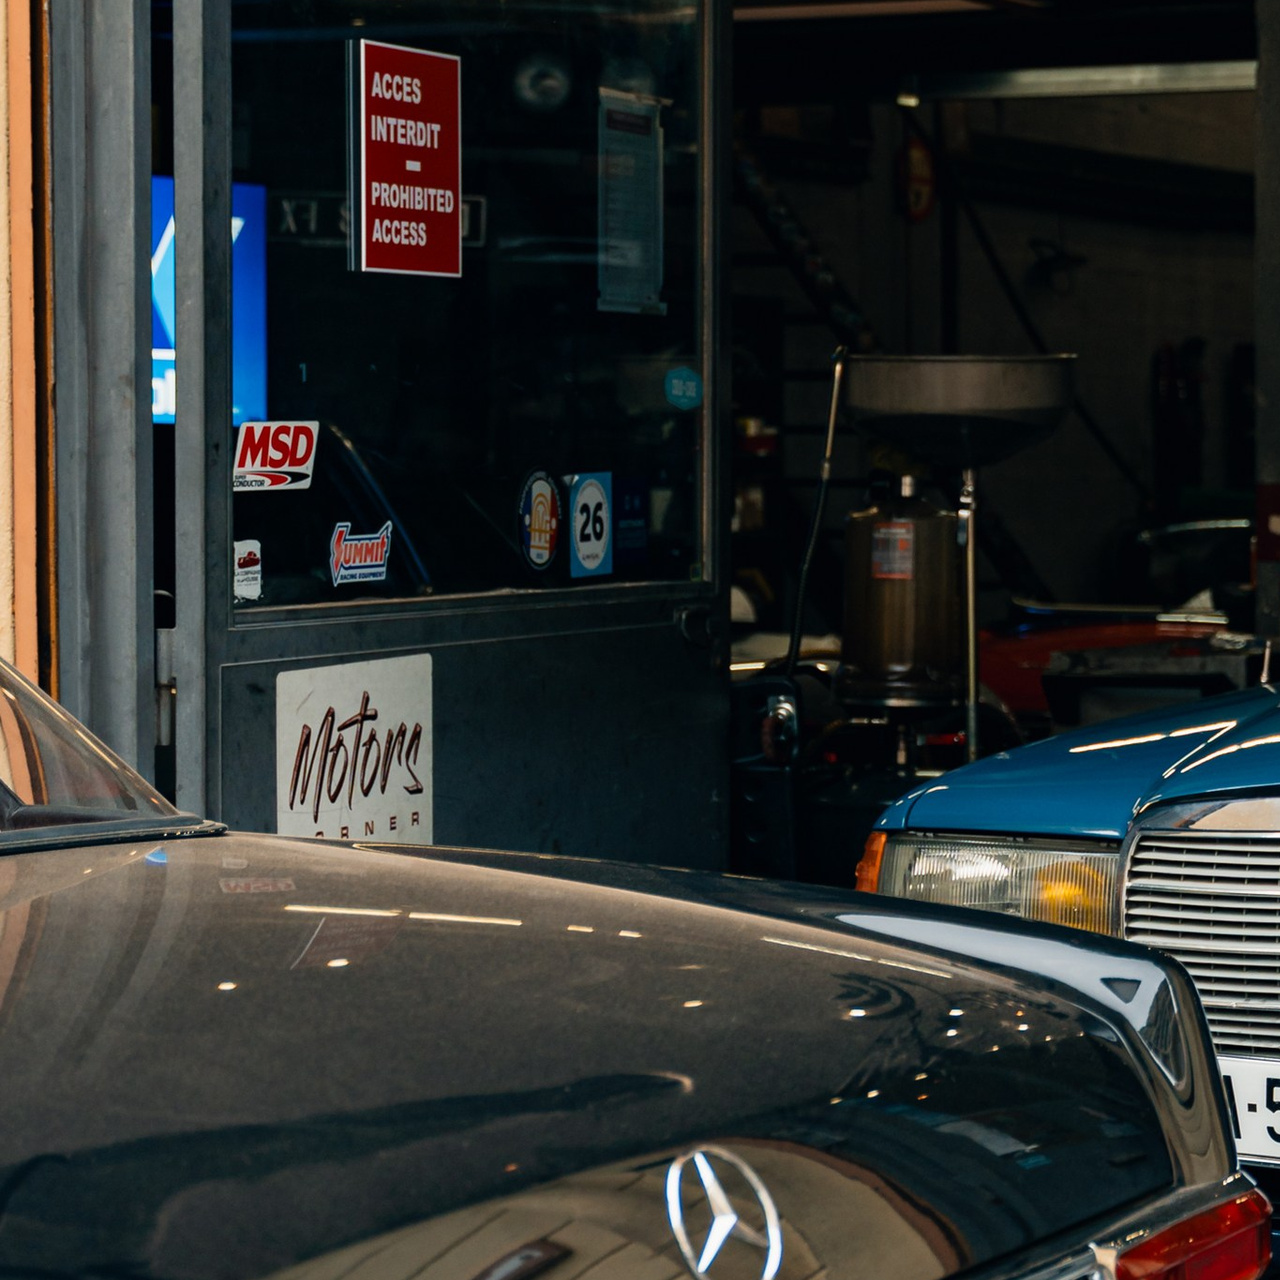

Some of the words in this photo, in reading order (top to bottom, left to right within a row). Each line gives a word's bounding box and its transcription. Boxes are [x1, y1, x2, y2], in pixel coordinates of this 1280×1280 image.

[371, 71, 422, 105] ACCES
[370, 115, 441, 149] INTERDIT
[371, 181, 454, 214] PROHIBITED
[372, 218, 427, 247] ACCESS
[237, 424, 315, 470] MSD
[579, 502, 605, 543] 26
[289, 690, 424, 824] Motors
[315, 811, 420, 839] RNER
